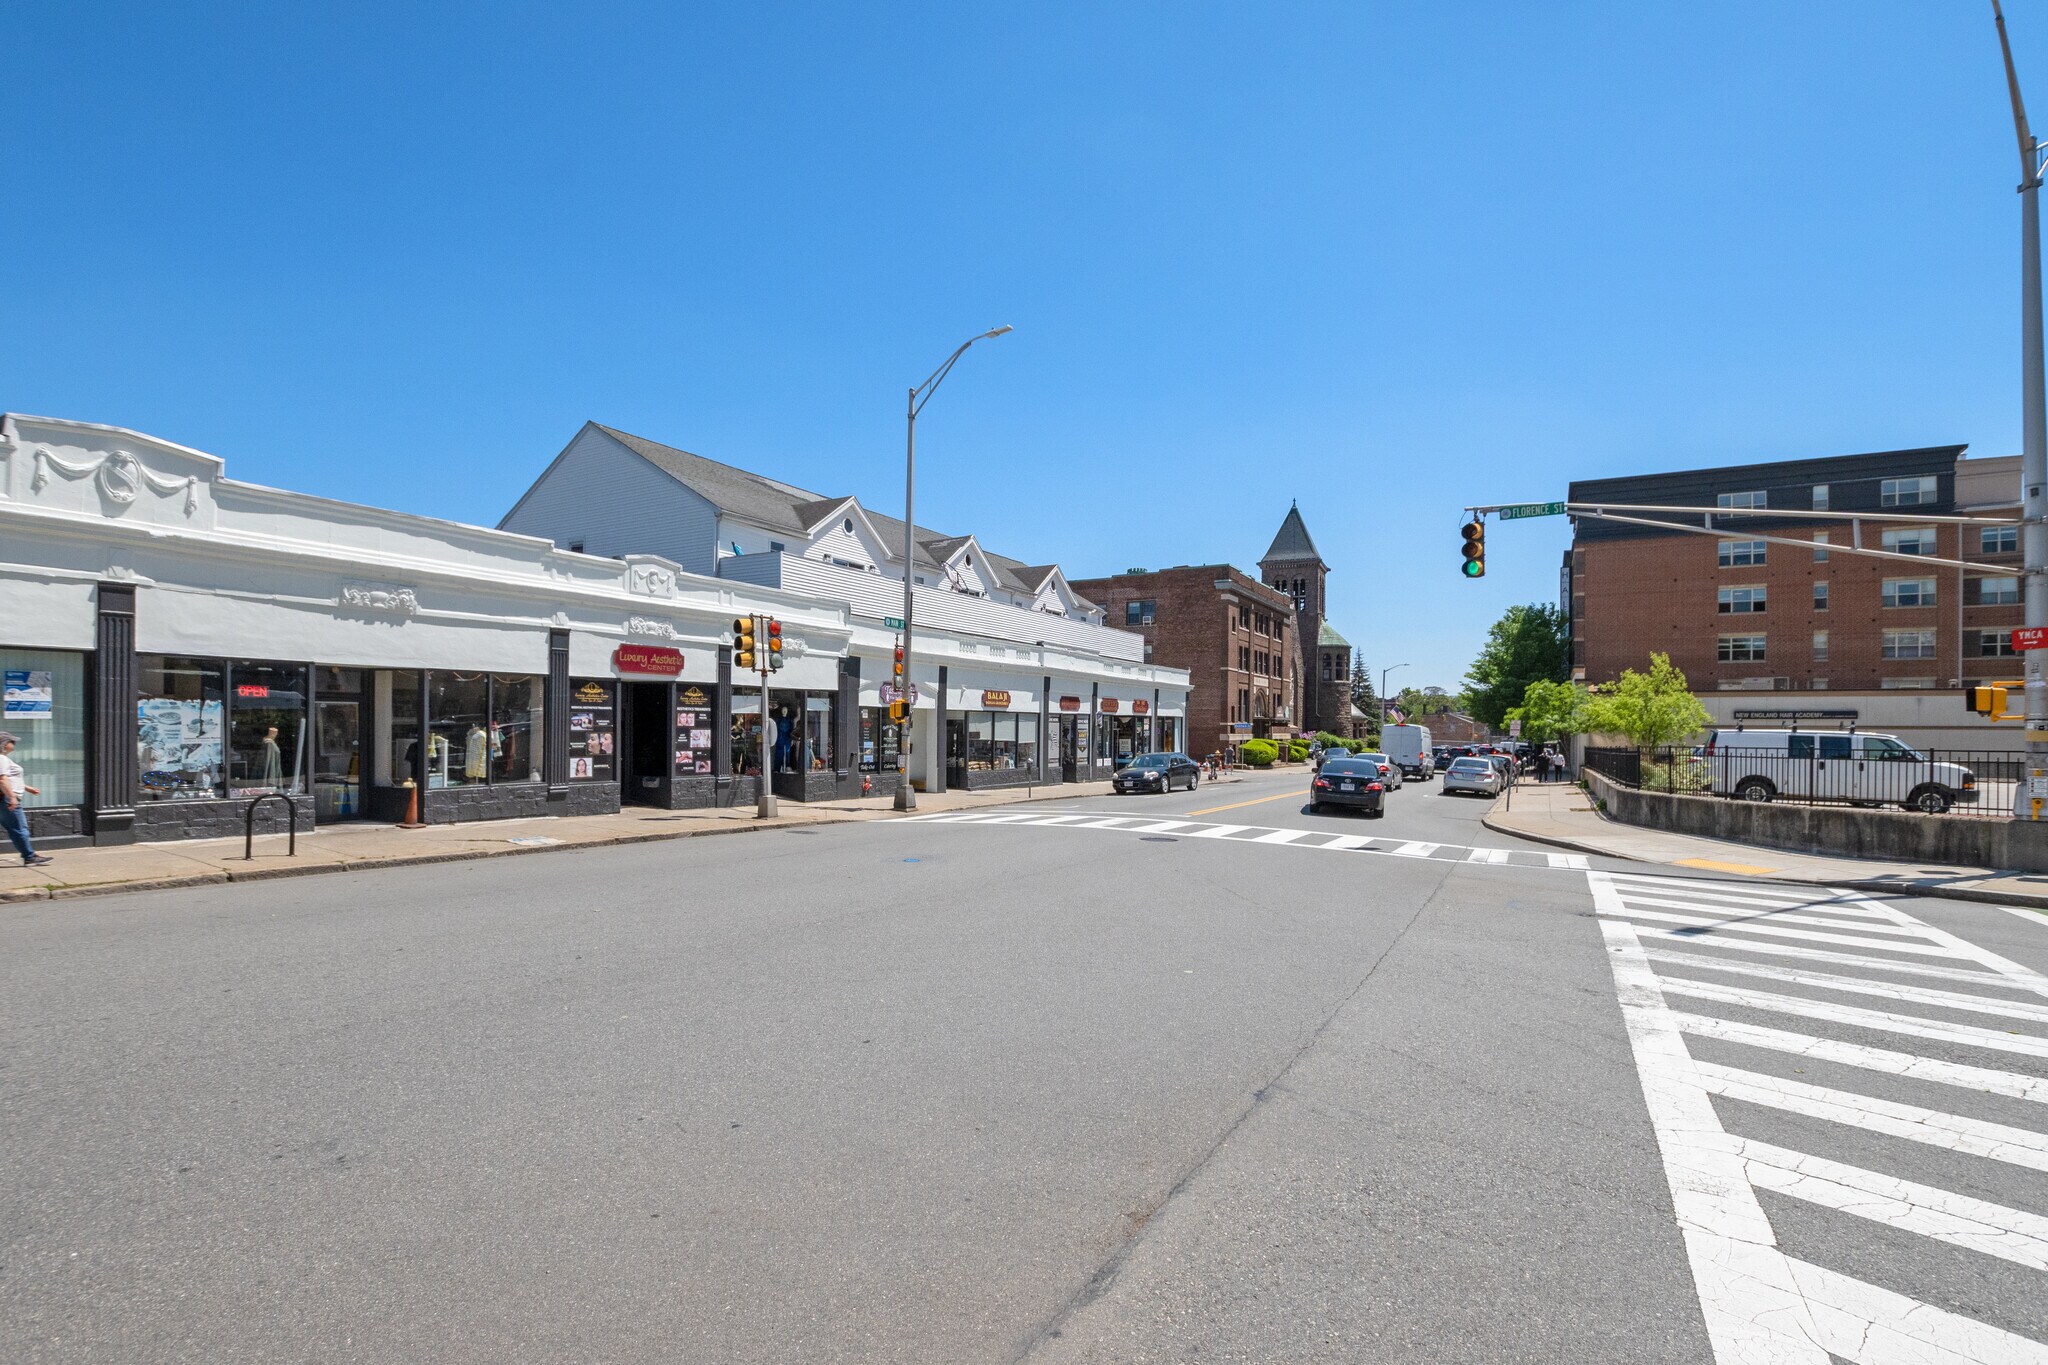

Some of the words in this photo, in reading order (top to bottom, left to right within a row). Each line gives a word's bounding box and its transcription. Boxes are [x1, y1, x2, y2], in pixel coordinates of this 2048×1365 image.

[1512, 504, 1550, 518] FLORENCE
[1553, 503, 1564, 514] ST
[890, 618, 899, 627] MAIN
[2018, 630, 2044, 640] YMCA
[619, 651, 648, 668] Luxury
[647, 664, 676, 672] CENTER
[238, 685, 268, 697] OPEN
[987, 691, 1008, 701] BALAJI
